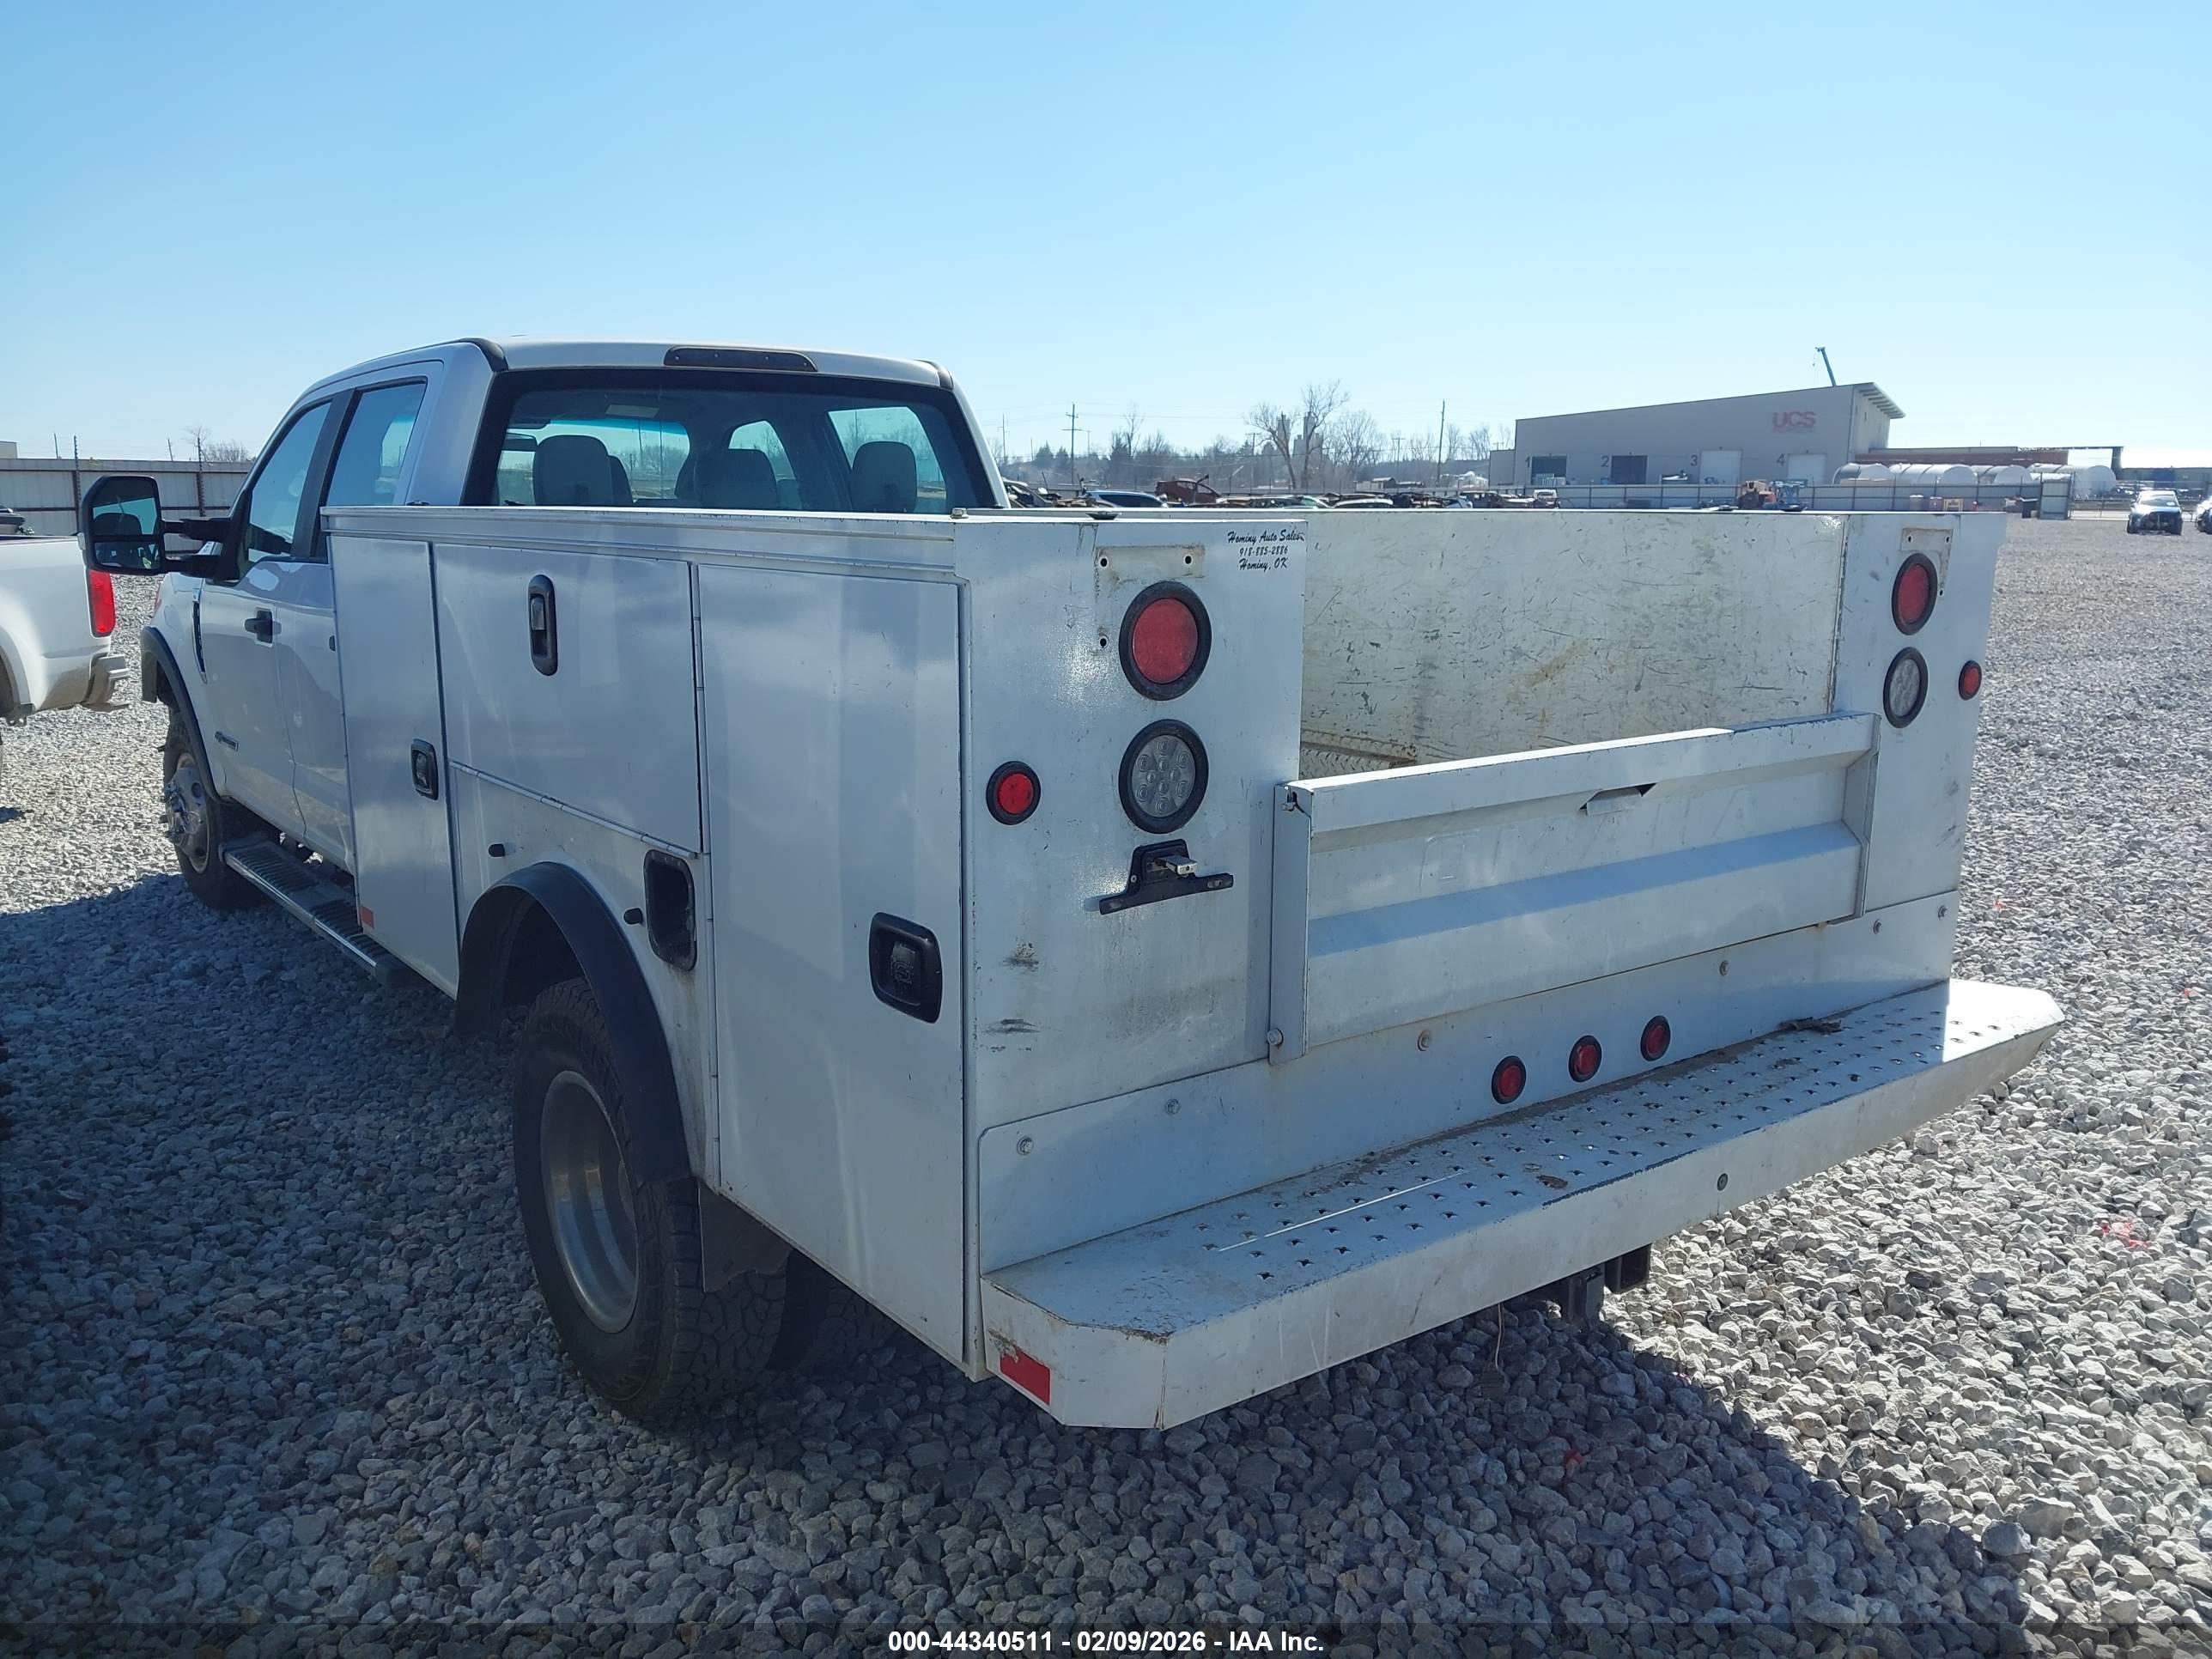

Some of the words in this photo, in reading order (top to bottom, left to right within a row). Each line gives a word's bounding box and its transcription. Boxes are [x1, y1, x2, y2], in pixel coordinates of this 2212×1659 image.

[1772, 410, 1817, 428] UCS
[1601, 455, 1610, 468] 2
[1690, 454, 1698, 467] 3
[1776, 453, 1785, 466] 4
[1227, 531, 1256, 545] Hominy
[1259, 530, 1278, 543] Auto
[1279, 529, 1301, 542] Sales
[1239, 545, 1288, 557] 918-885-2886
[1239, 558, 1271, 573] Hominy,
[1274, 557, 1289, 568] OK
